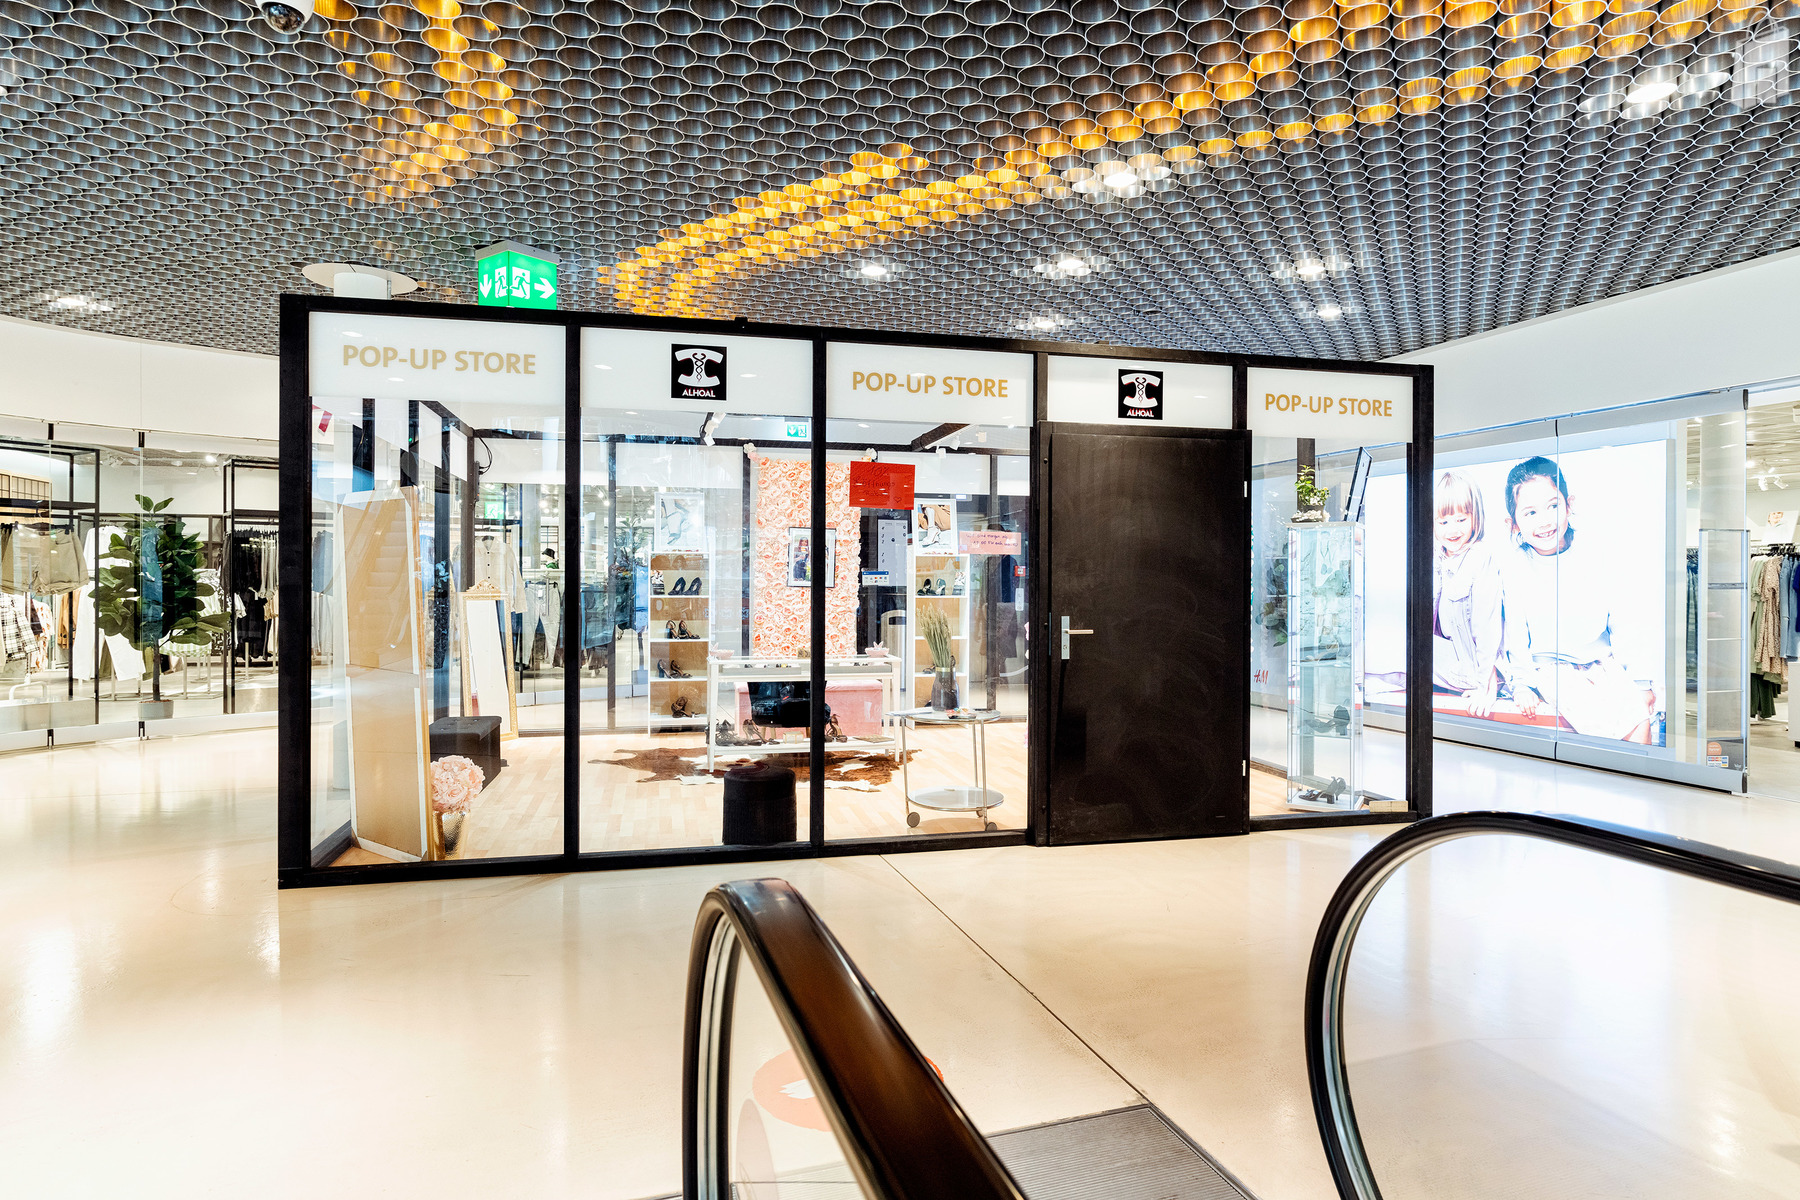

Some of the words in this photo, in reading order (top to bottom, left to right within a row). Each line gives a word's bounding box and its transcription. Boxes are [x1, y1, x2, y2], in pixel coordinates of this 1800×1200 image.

[343, 344, 447, 370] POP-UP
[454, 350, 536, 375] STORE
[681, 387, 716, 398] ALHOAL
[852, 371, 937, 394] POP-UP
[942, 376, 1008, 398] STORE
[1126, 408, 1155, 418] ALHOAL
[1265, 393, 1334, 414] POP-UP
[1338, 397, 1393, 417] STORE
